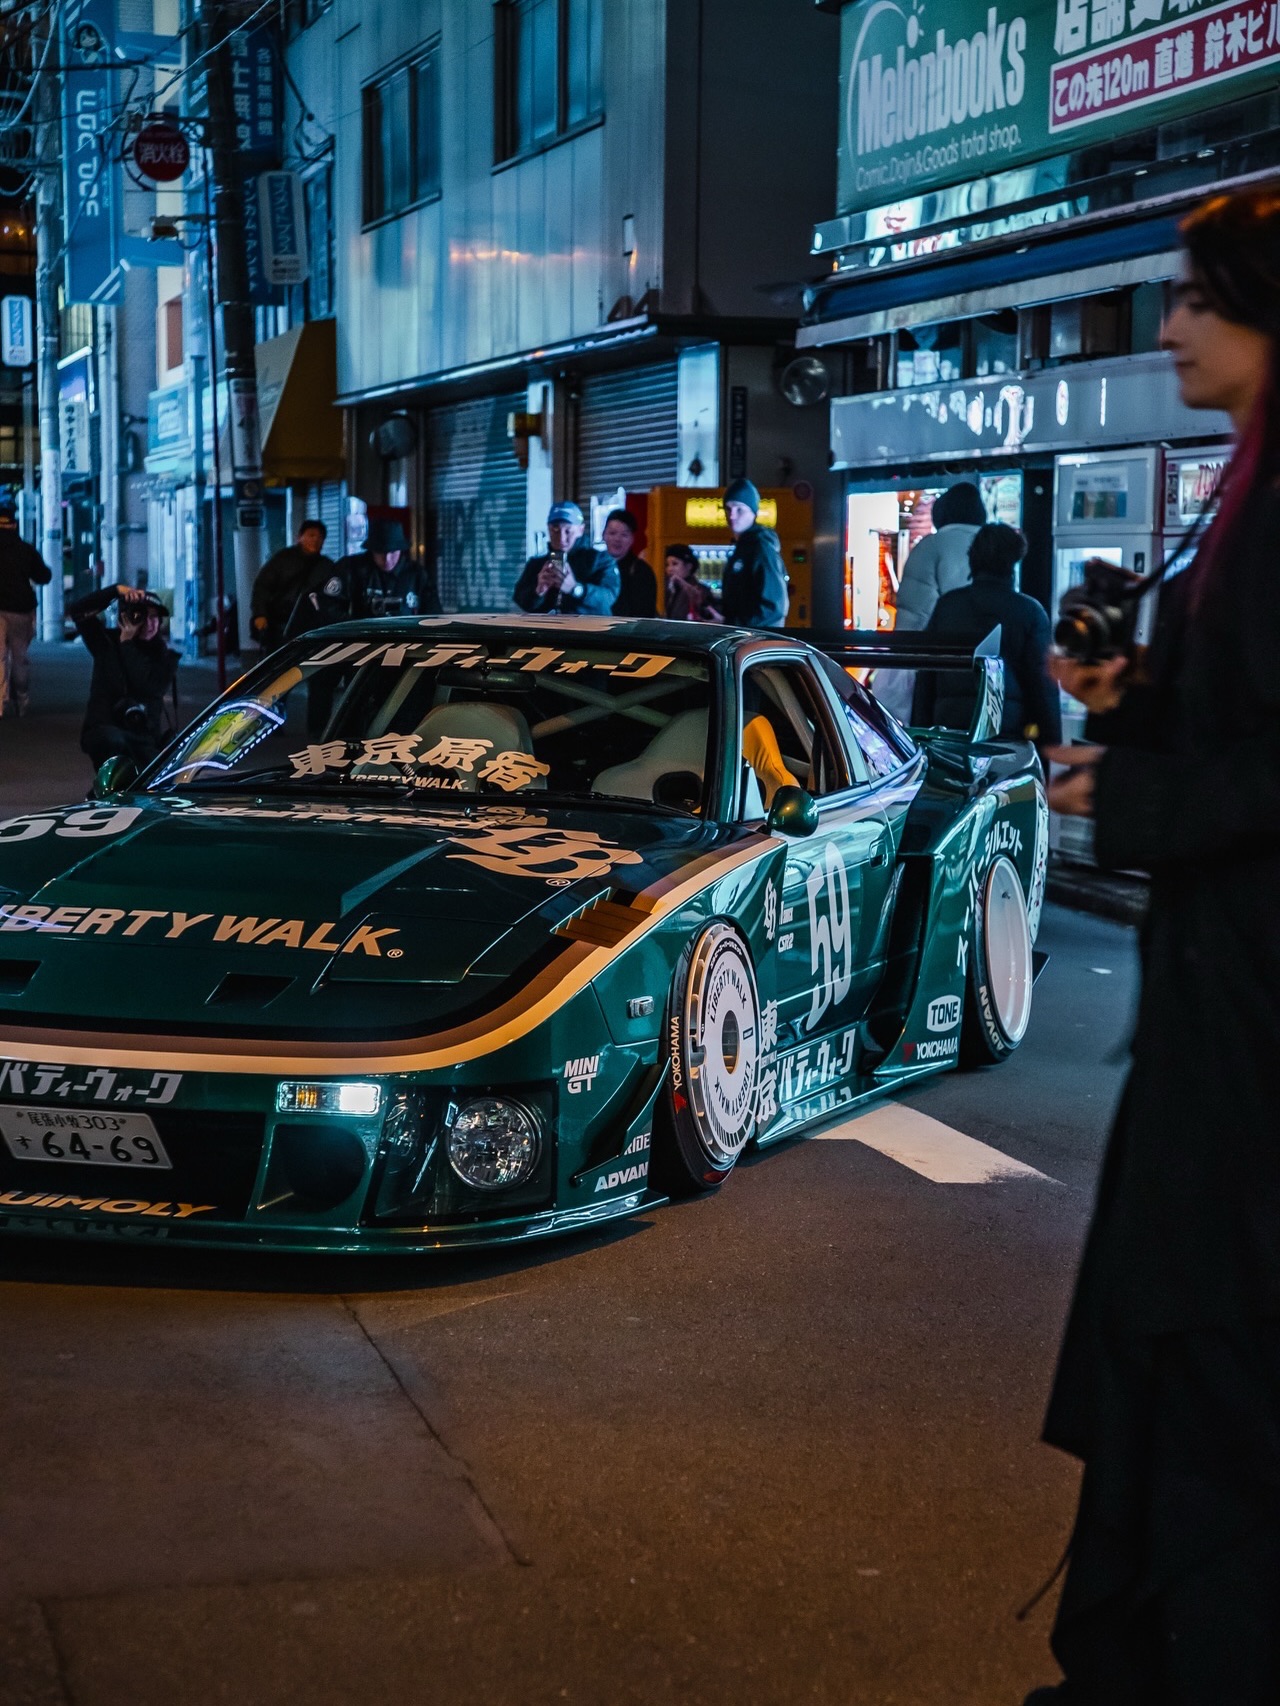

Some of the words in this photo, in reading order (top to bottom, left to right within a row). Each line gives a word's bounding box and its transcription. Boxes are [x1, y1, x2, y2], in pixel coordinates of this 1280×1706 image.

[857, 6, 1026, 156] Melonbooks
[1054, 53, 1149, 117] この先120m
[1154, 29, 1195, 88] 直進
[139, 142, 186, 164] 消火栓
[961, 126, 988, 160] total
[300, 642, 677, 678] リバティーウォーク
[0, 807, 144, 843] 59
[806, 841, 851, 1031] 59
[710, 968, 730, 1024] LIBERTY
[731, 969, 747, 1010] WALK
[931, 1001, 959, 1026] TONE
[979, 985, 1005, 1051] ADVAN
[671, 1015, 682, 1091] YOKOHAMA
[916, 1037, 958, 1060] YOKOHAMA
[564, 1055, 599, 1078] MINI
[567, 1073, 597, 1094] GT
[14, 1136, 32, 1149] す
[42, 1131, 160, 1164] 64-69
[594, 1161, 649, 1192] ADVAN
